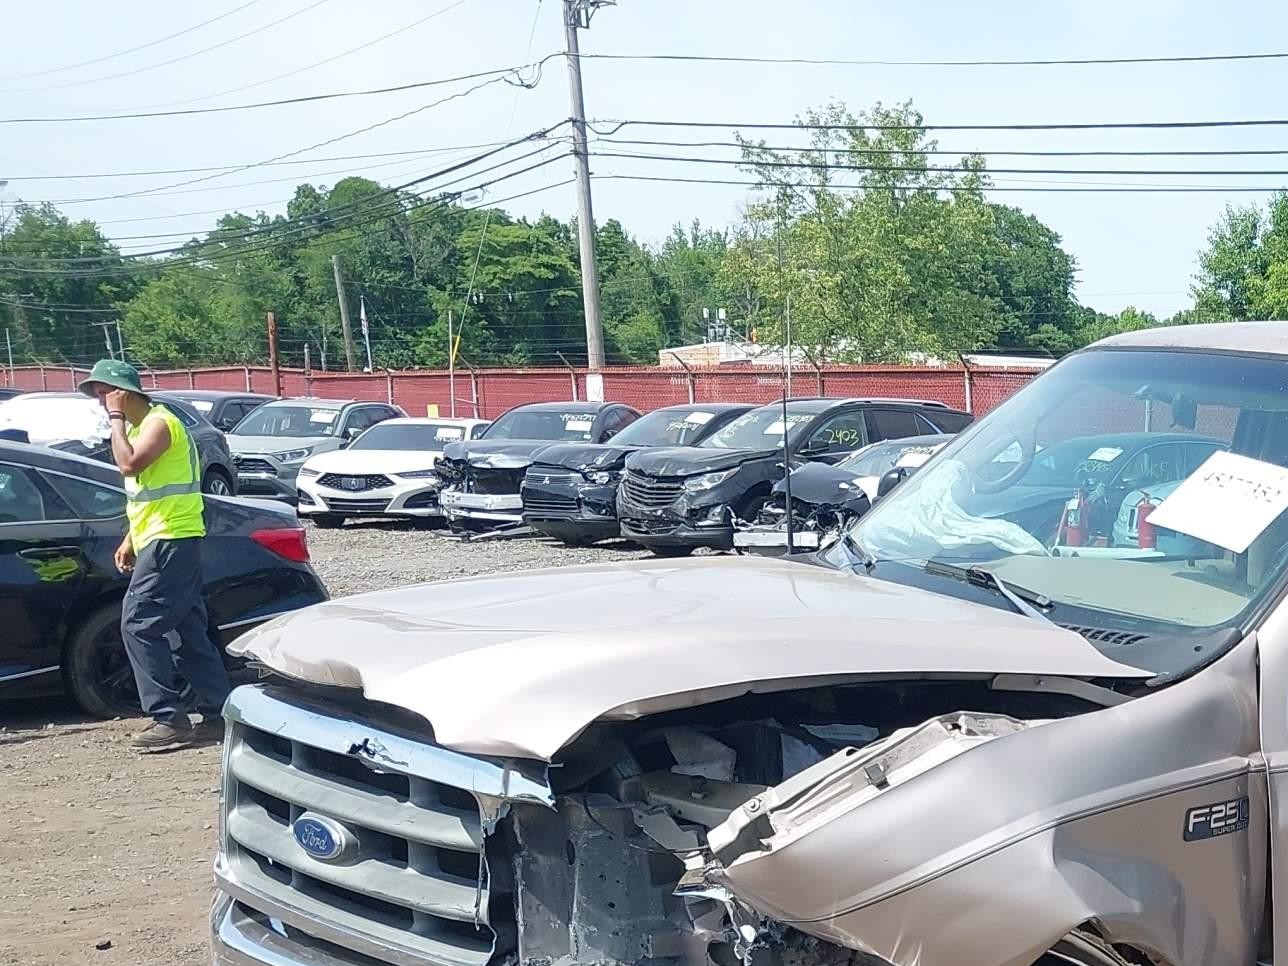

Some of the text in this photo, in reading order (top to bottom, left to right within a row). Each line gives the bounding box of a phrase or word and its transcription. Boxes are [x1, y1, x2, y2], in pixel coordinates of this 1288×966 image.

[825, 429, 860, 447] 2403
[302, 823, 328, 850] Ford
[1212, 825, 1236, 836] SUPER
